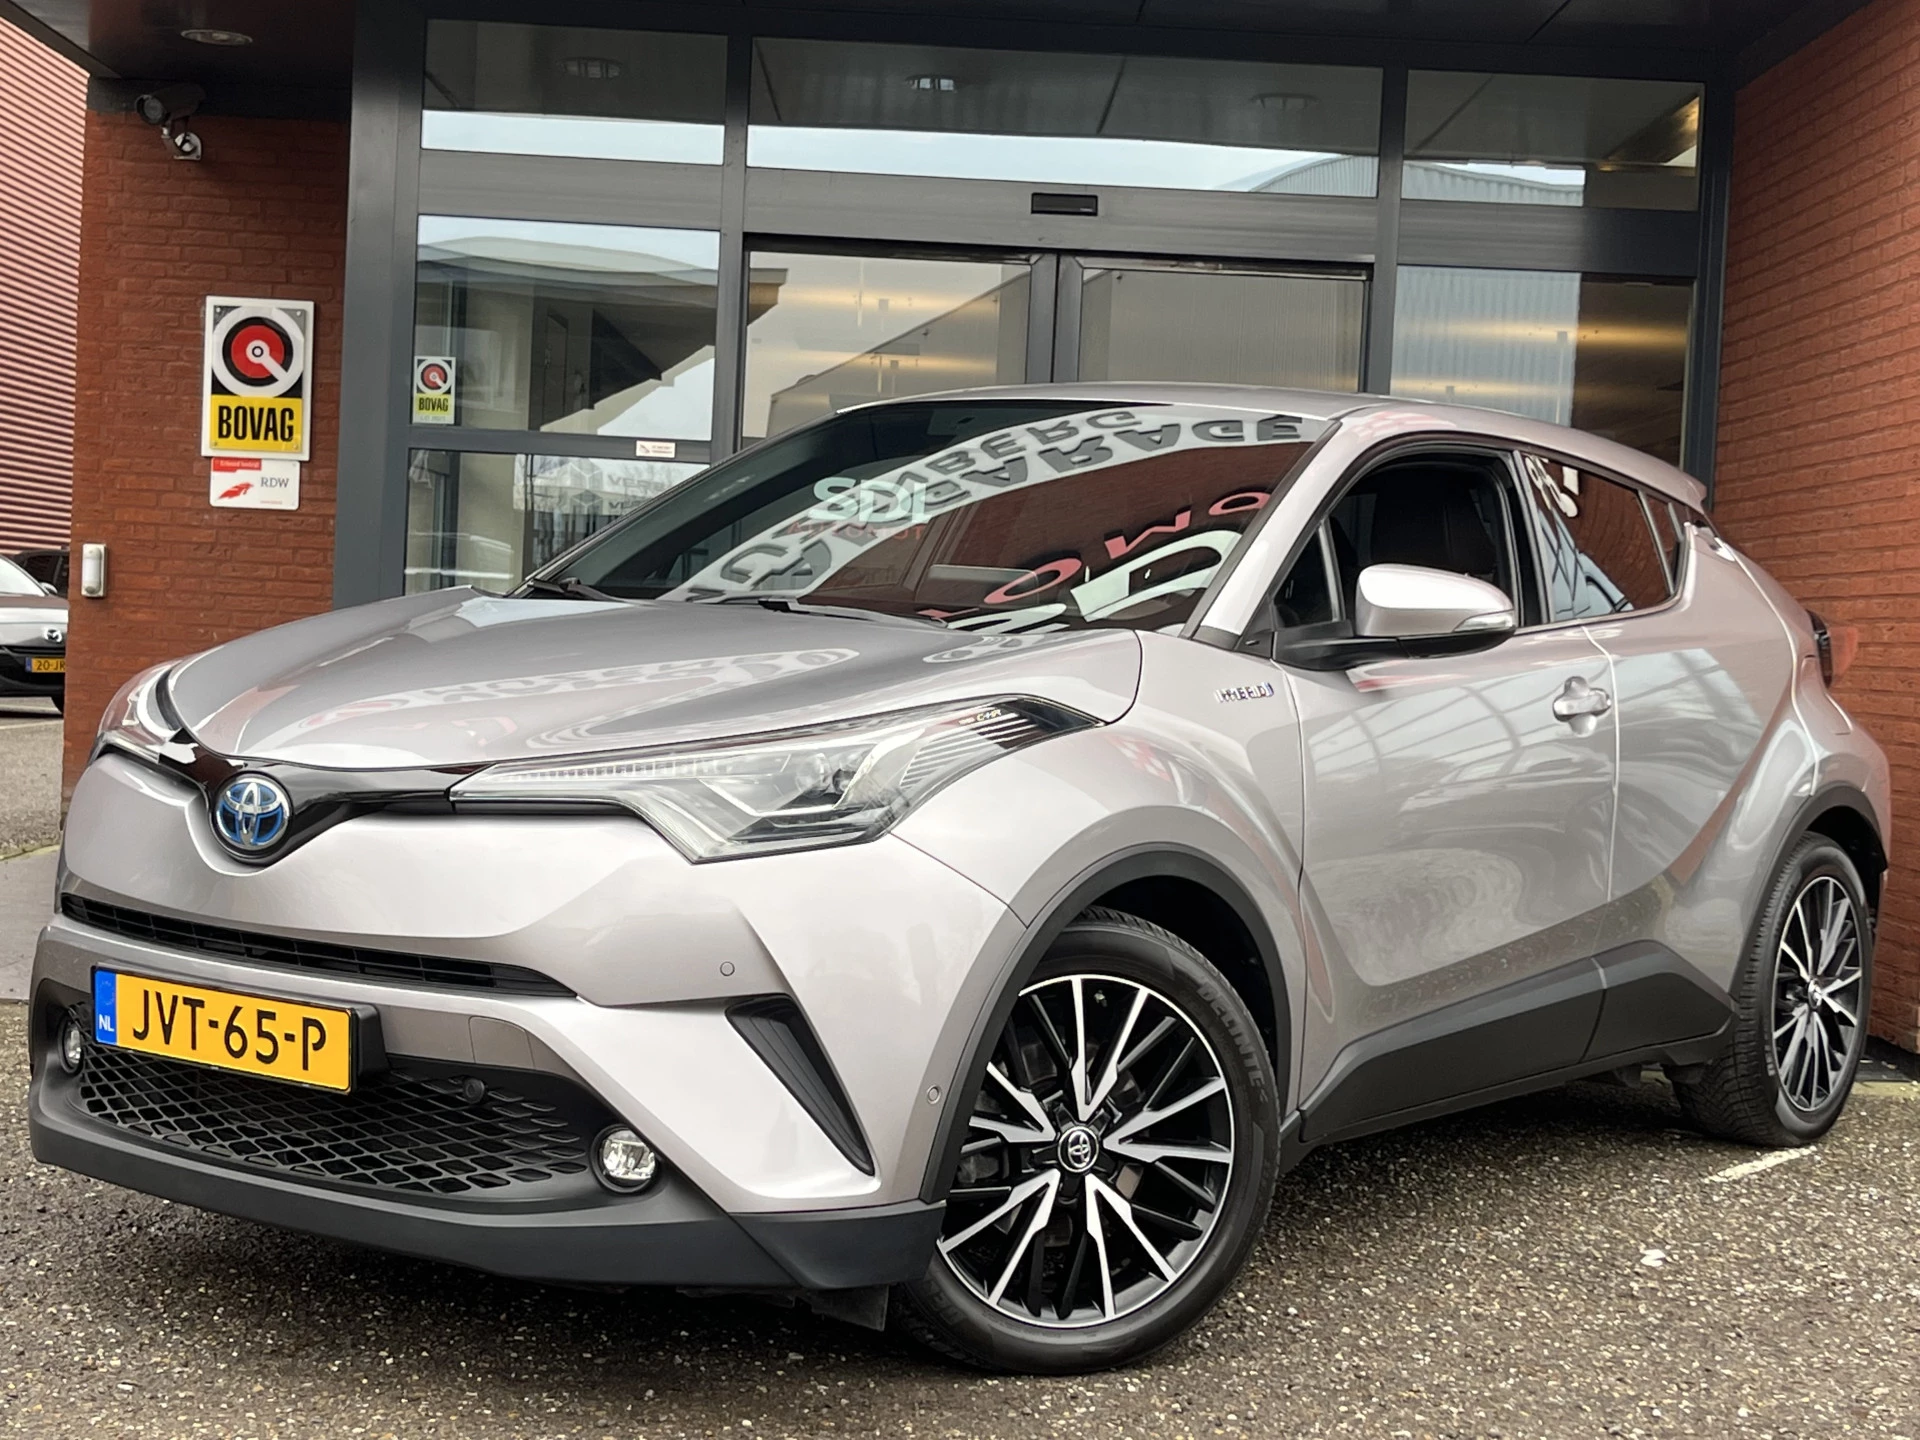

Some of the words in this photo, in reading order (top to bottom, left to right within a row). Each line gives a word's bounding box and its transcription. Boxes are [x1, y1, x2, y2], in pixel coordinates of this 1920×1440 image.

[418, 397, 448, 412] BOVAG
[218, 405, 294, 442] BOVAG
[260, 477, 289, 488] RDW
[98, 1014, 115, 1032] NL
[133, 989, 327, 1071] JVT-65-P
